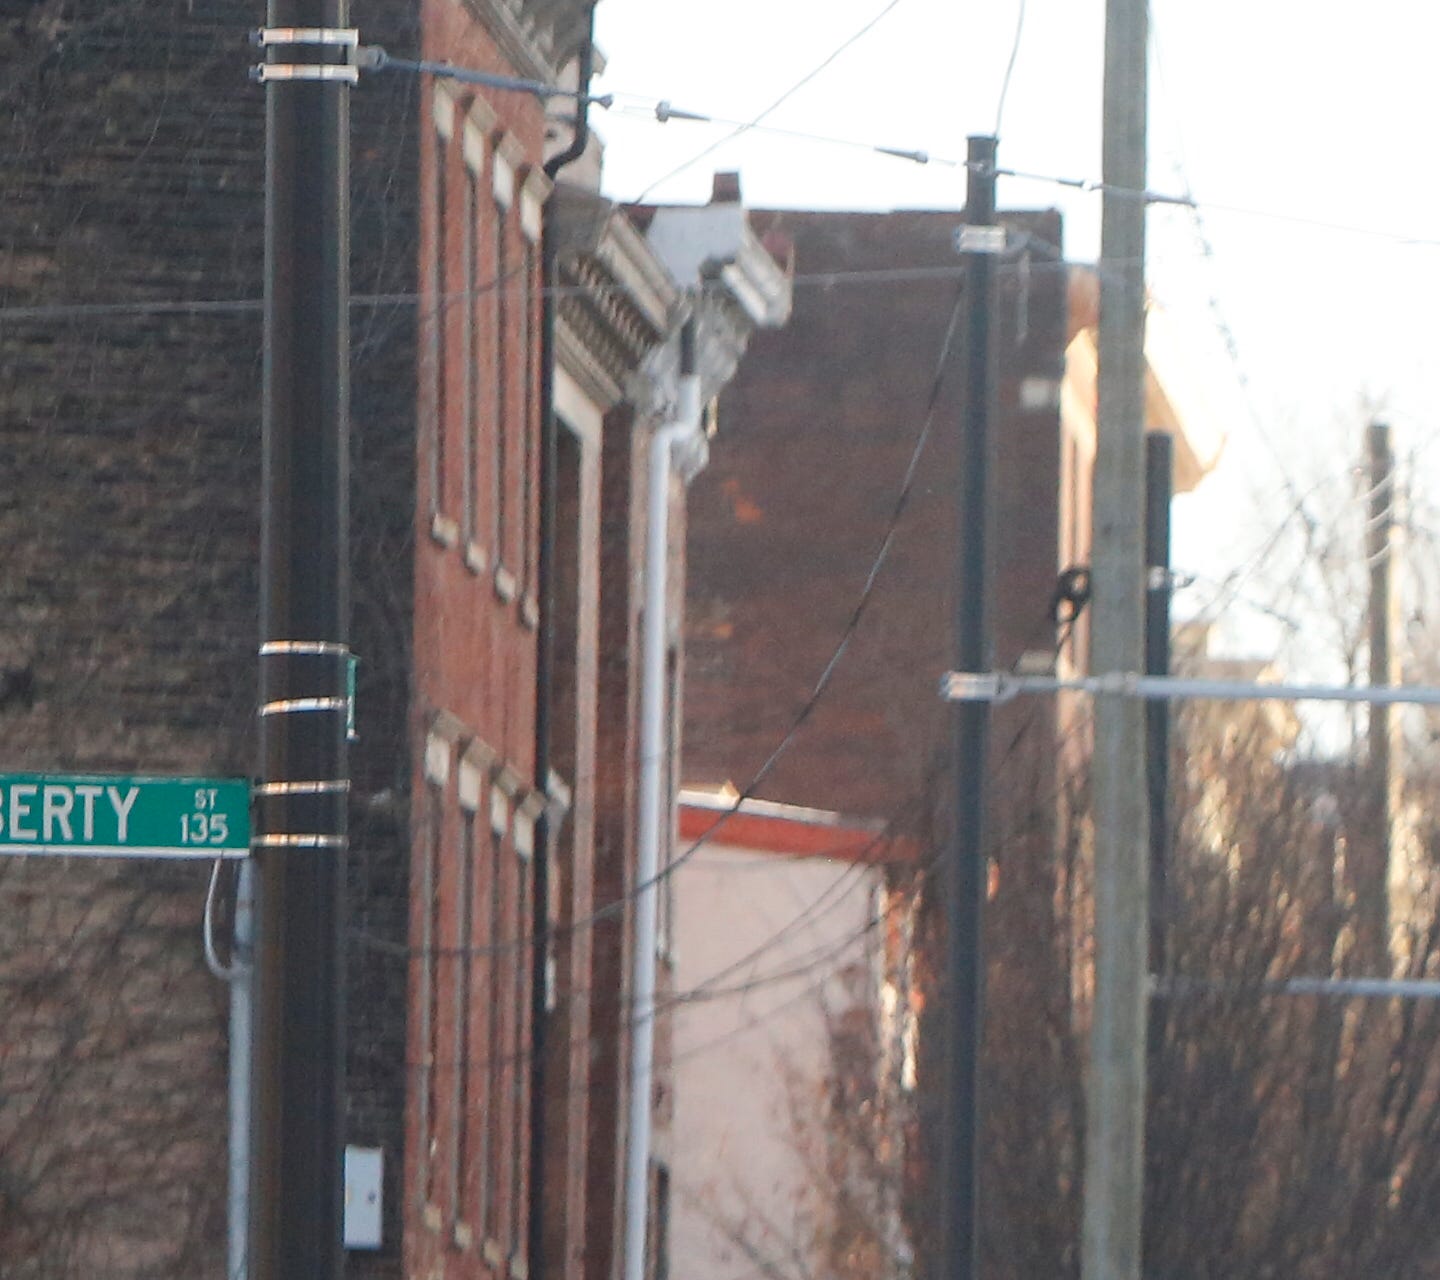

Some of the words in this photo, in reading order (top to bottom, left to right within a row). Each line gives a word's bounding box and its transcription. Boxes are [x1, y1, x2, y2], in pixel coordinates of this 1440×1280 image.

[0, 783, 140, 844] ERTY
[194, 788, 217, 810] ST
[179, 812, 229, 845] 135
